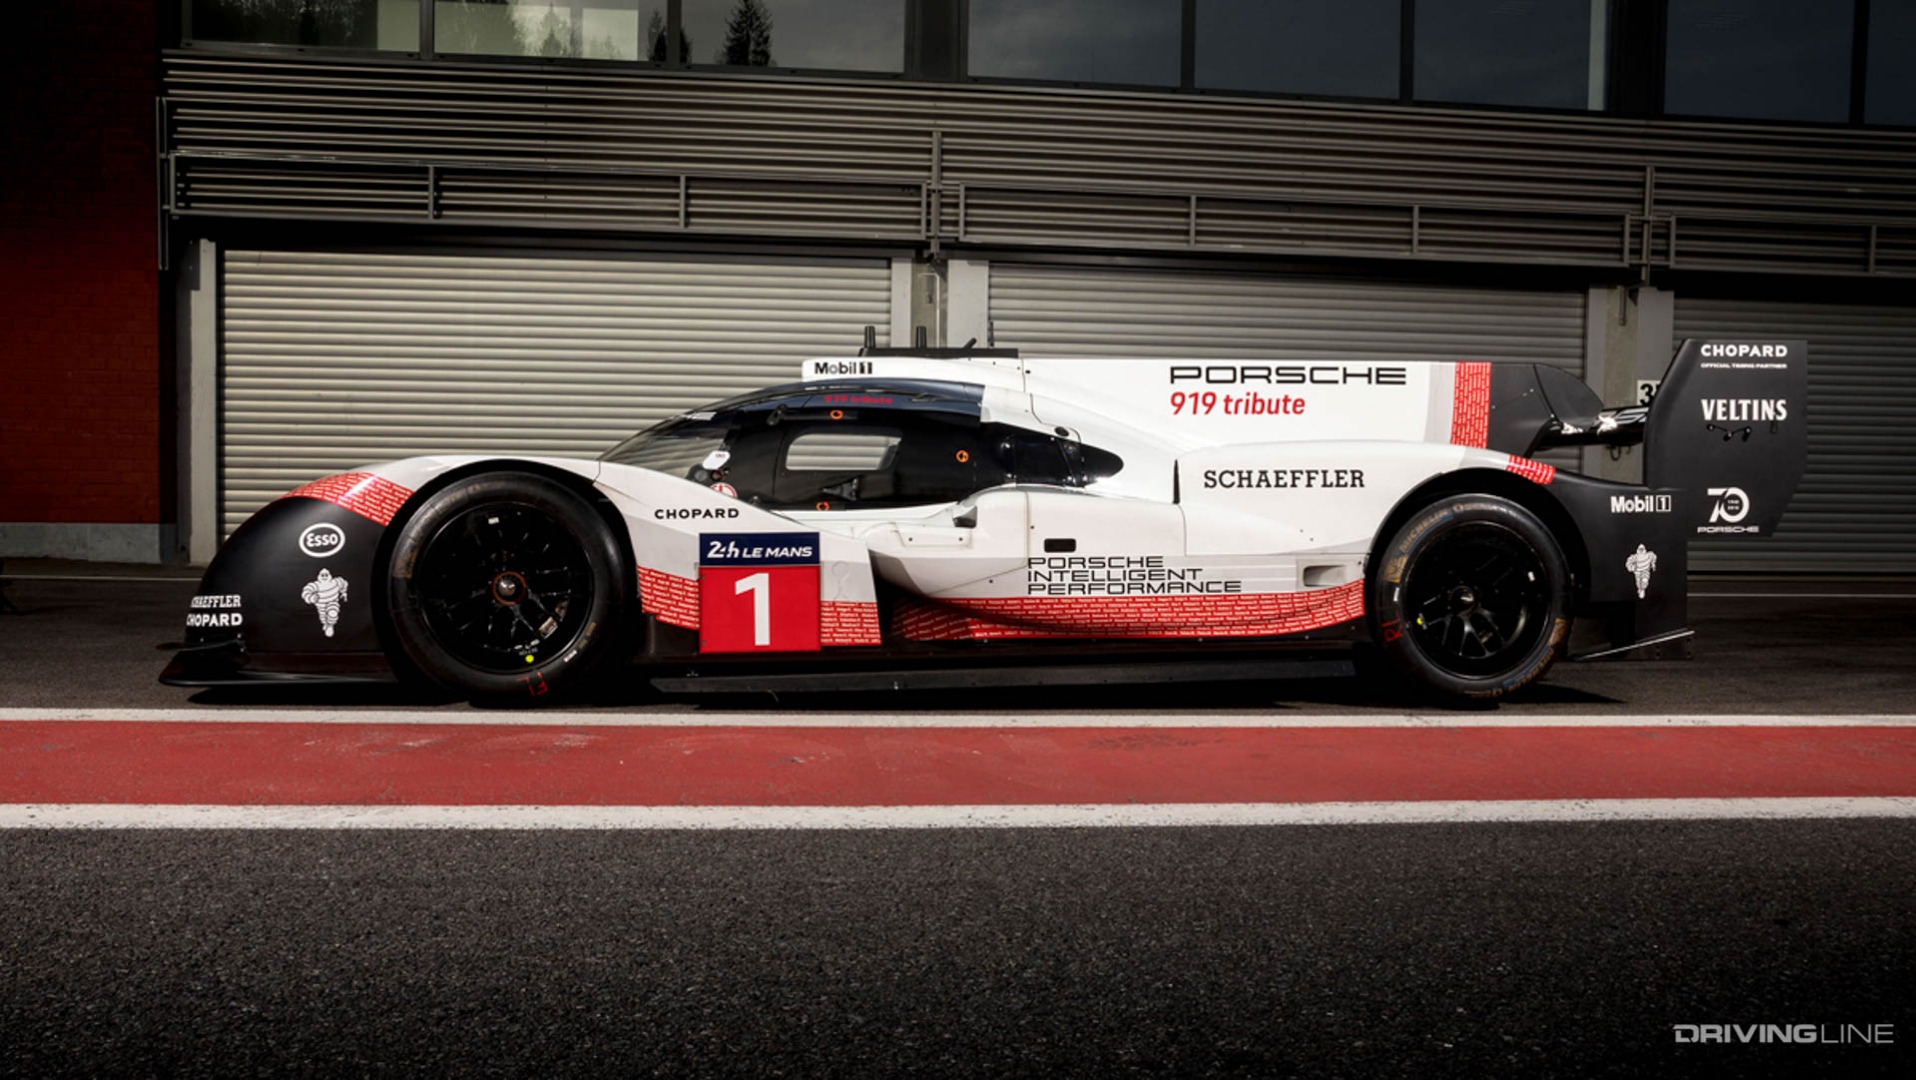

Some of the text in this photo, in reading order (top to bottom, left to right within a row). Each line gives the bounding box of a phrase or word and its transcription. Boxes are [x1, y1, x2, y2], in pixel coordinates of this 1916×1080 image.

[1700, 344, 1788, 357] CHOPARD
[814, 362, 873, 374] Mobil 1
[1170, 366, 1407, 385] PORSCHE
[1170, 391, 1306, 415] 919 tribute
[1640, 383, 1660, 406] 3
[1700, 399, 1788, 421] VELTINS
[1203, 469, 1365, 489] SCHAEFFLER
[1610, 495, 1654, 513] Mobil
[1707, 487, 1750, 523] 70
[654, 508, 740, 520] CHOPARD
[306, 533, 339, 547] Esso
[707, 541, 813, 558] 24h LE MANS
[1028, 556, 1163, 569] PORSCHE
[1028, 568, 1203, 582] INTELLIGENT
[1028, 581, 1242, 595] PERFORMANCE
[735, 572, 770, 646] 1
